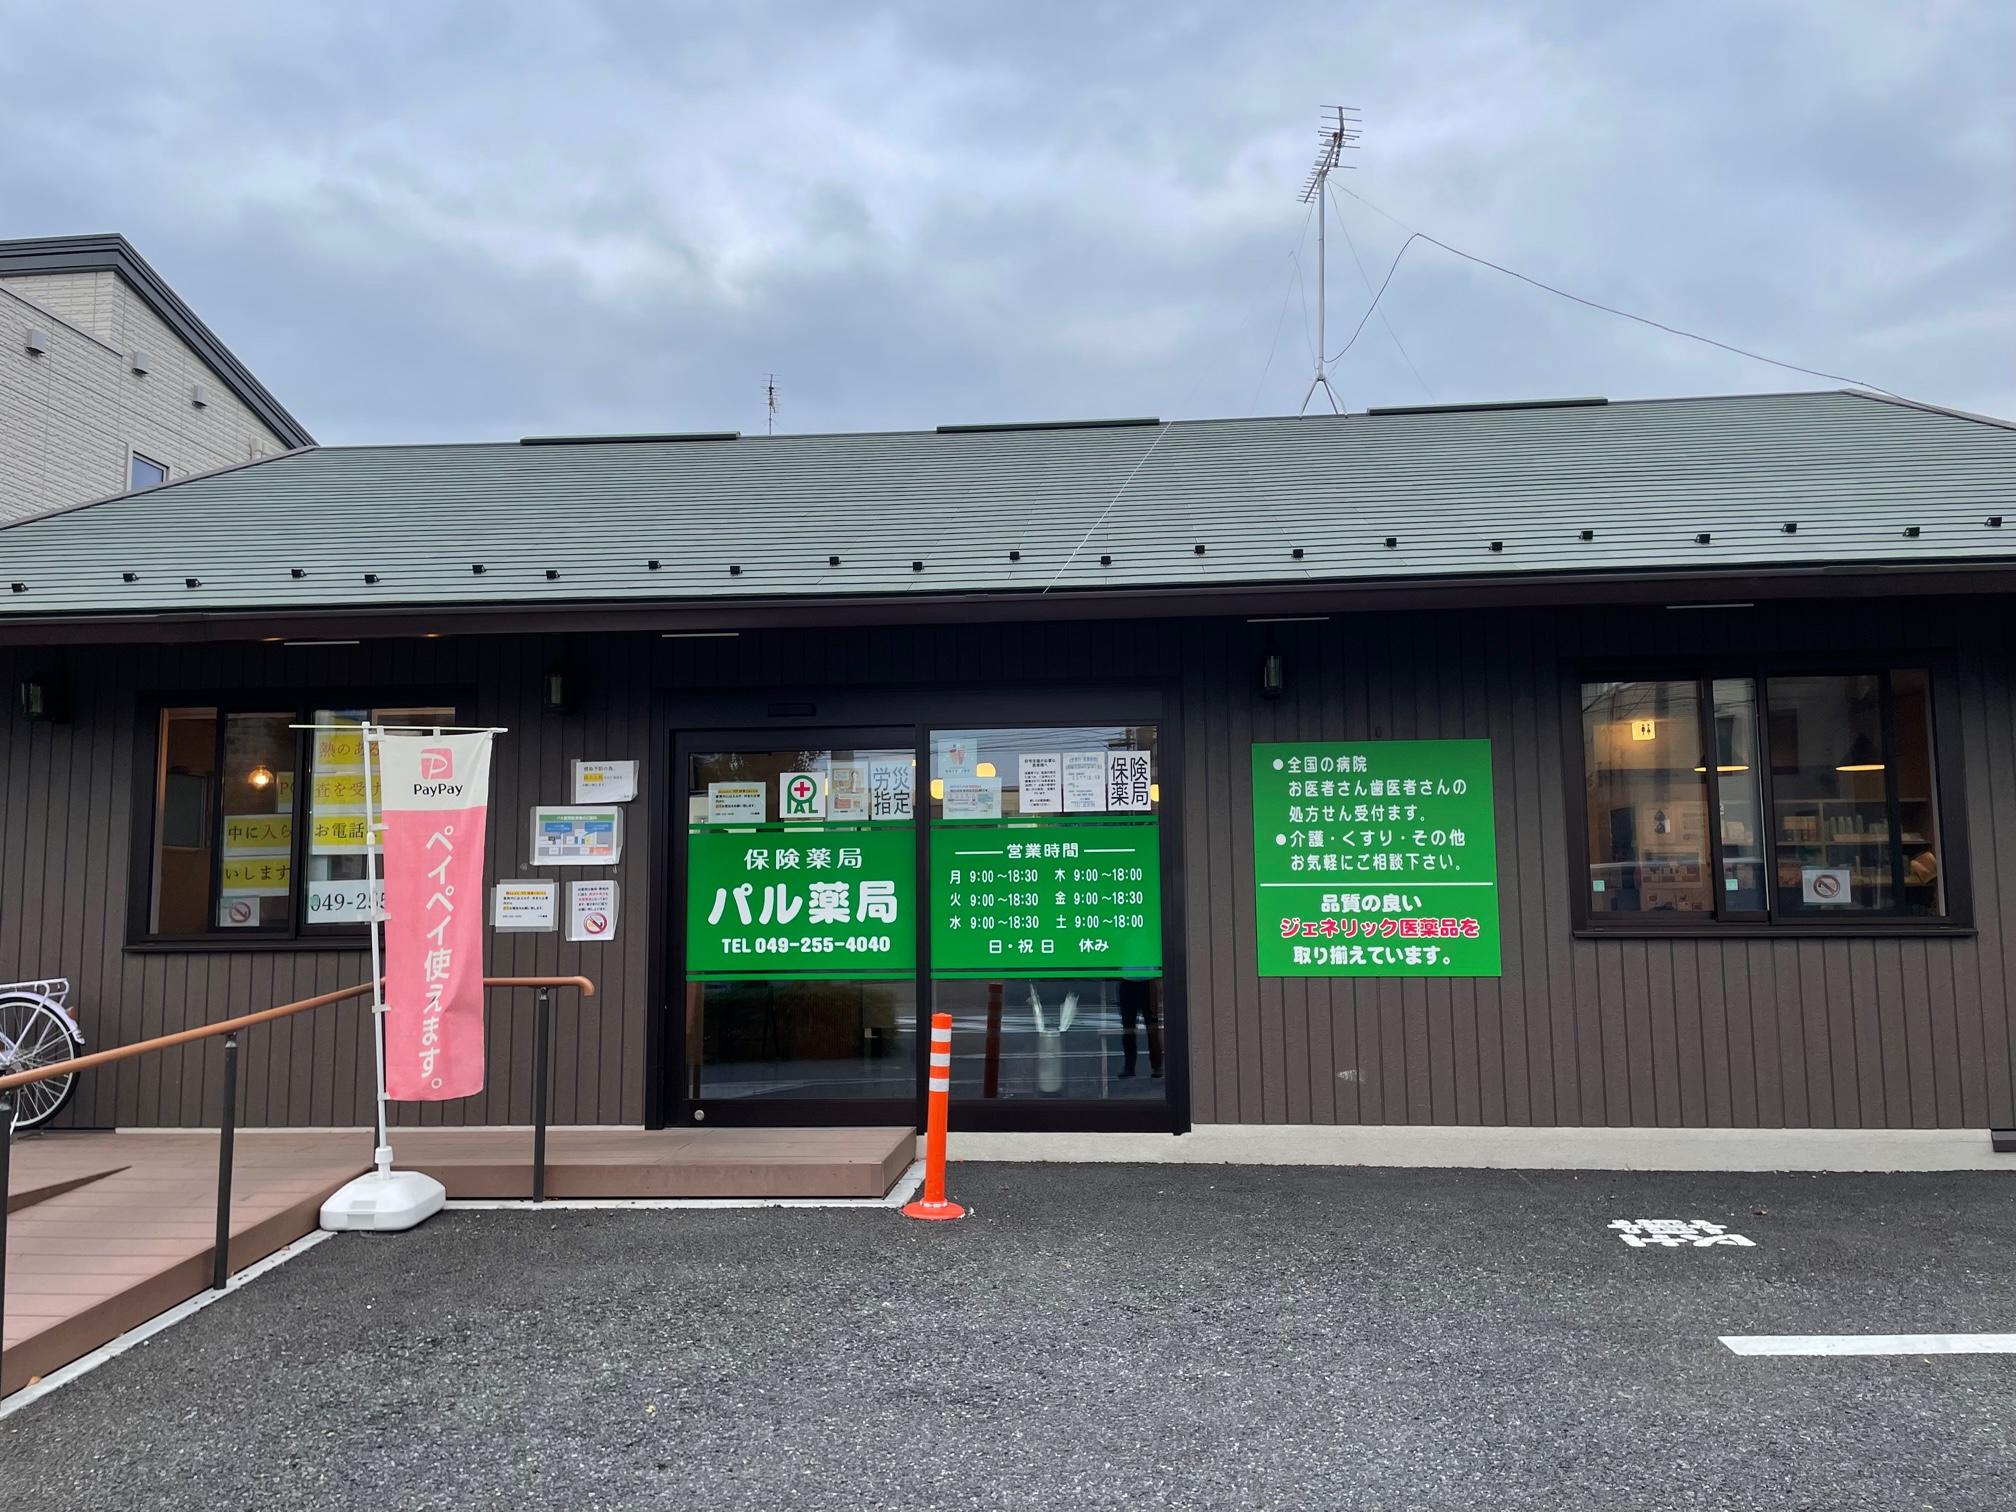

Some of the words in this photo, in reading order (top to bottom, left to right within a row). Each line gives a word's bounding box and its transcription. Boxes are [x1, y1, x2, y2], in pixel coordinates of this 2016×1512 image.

[1111, 757, 1148, 781] 保険
[1287, 755, 1367, 774] 全国の病院
[874, 767, 909, 791] 労災
[1288, 778, 1467, 797] お医者さん歯医者さんの
[414, 783, 463, 797] PayPay
[1111, 781, 1149, 806] 薬局
[875, 791, 911, 816] 指定
[1289, 804, 1425, 823] 処方せん受付ます。
[315, 822, 377, 839] お電話
[1290, 828, 1466, 848] 介護・くすり・その他
[743, 847, 862, 870] 保険薬局
[1006, 842, 1079, 859] 営業時間
[1290, 853, 1460, 871] お気軽にご相談下さい。
[949, 869, 961, 885] 月
[1054, 868, 1066, 882] 木
[707, 880, 898, 925] パル薬局
[950, 892, 961, 906] 火
[1055, 891, 1066, 905] 金
[1320, 892, 1422, 914] 品質の良い
[949, 915, 961, 930] 水
[1056, 914, 1067, 929] 土
[1279, 916, 1481, 939] ジェネリック医薬品を
[721, 937, 752, 954] TEL
[755, 935, 891, 954] 049-255-4040
[1078, 938, 1109, 953] 休み
[419, 825, 454, 1089] ペイペイ使えます。
[1293, 945, 1451, 966] 取り揃えています。
